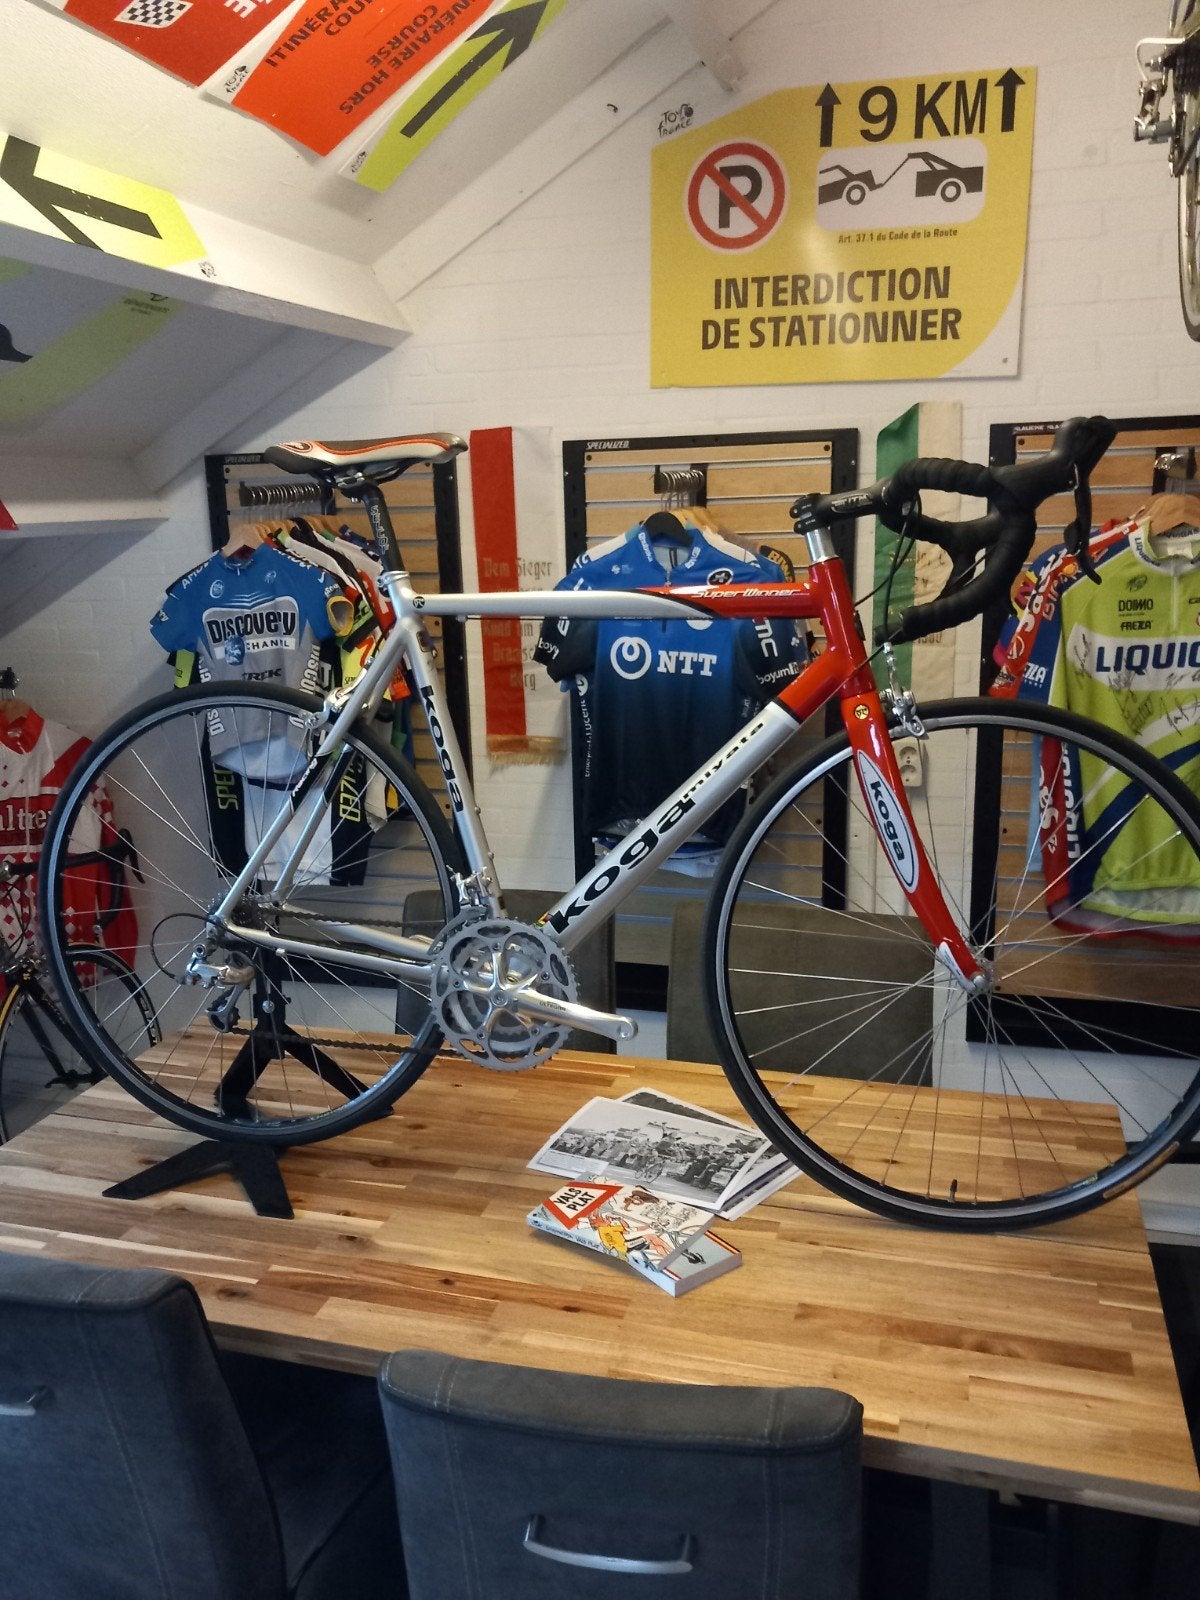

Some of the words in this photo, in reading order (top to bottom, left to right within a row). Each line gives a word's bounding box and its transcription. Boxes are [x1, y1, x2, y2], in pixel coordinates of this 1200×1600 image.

[365, 5, 439, 68] COURSE
[339, 68, 390, 115] HORS
[858, 85, 898, 143] 9
[913, 78, 989, 139] KM
[876, 232, 887, 242] du
[888, 230, 909, 241] Code
[911, 229, 921, 239] de
[923, 229, 931, 238] la
[933, 228, 958, 238] Route
[714, 265, 951, 310] INTERDICTION
[701, 318, 740, 350] DE
[749, 307, 962, 349] STATIONNER
[657, 650, 717, 677] NTT
[553, 1187, 583, 1205] VALS
[566, 1191, 597, 1212] PLAT
